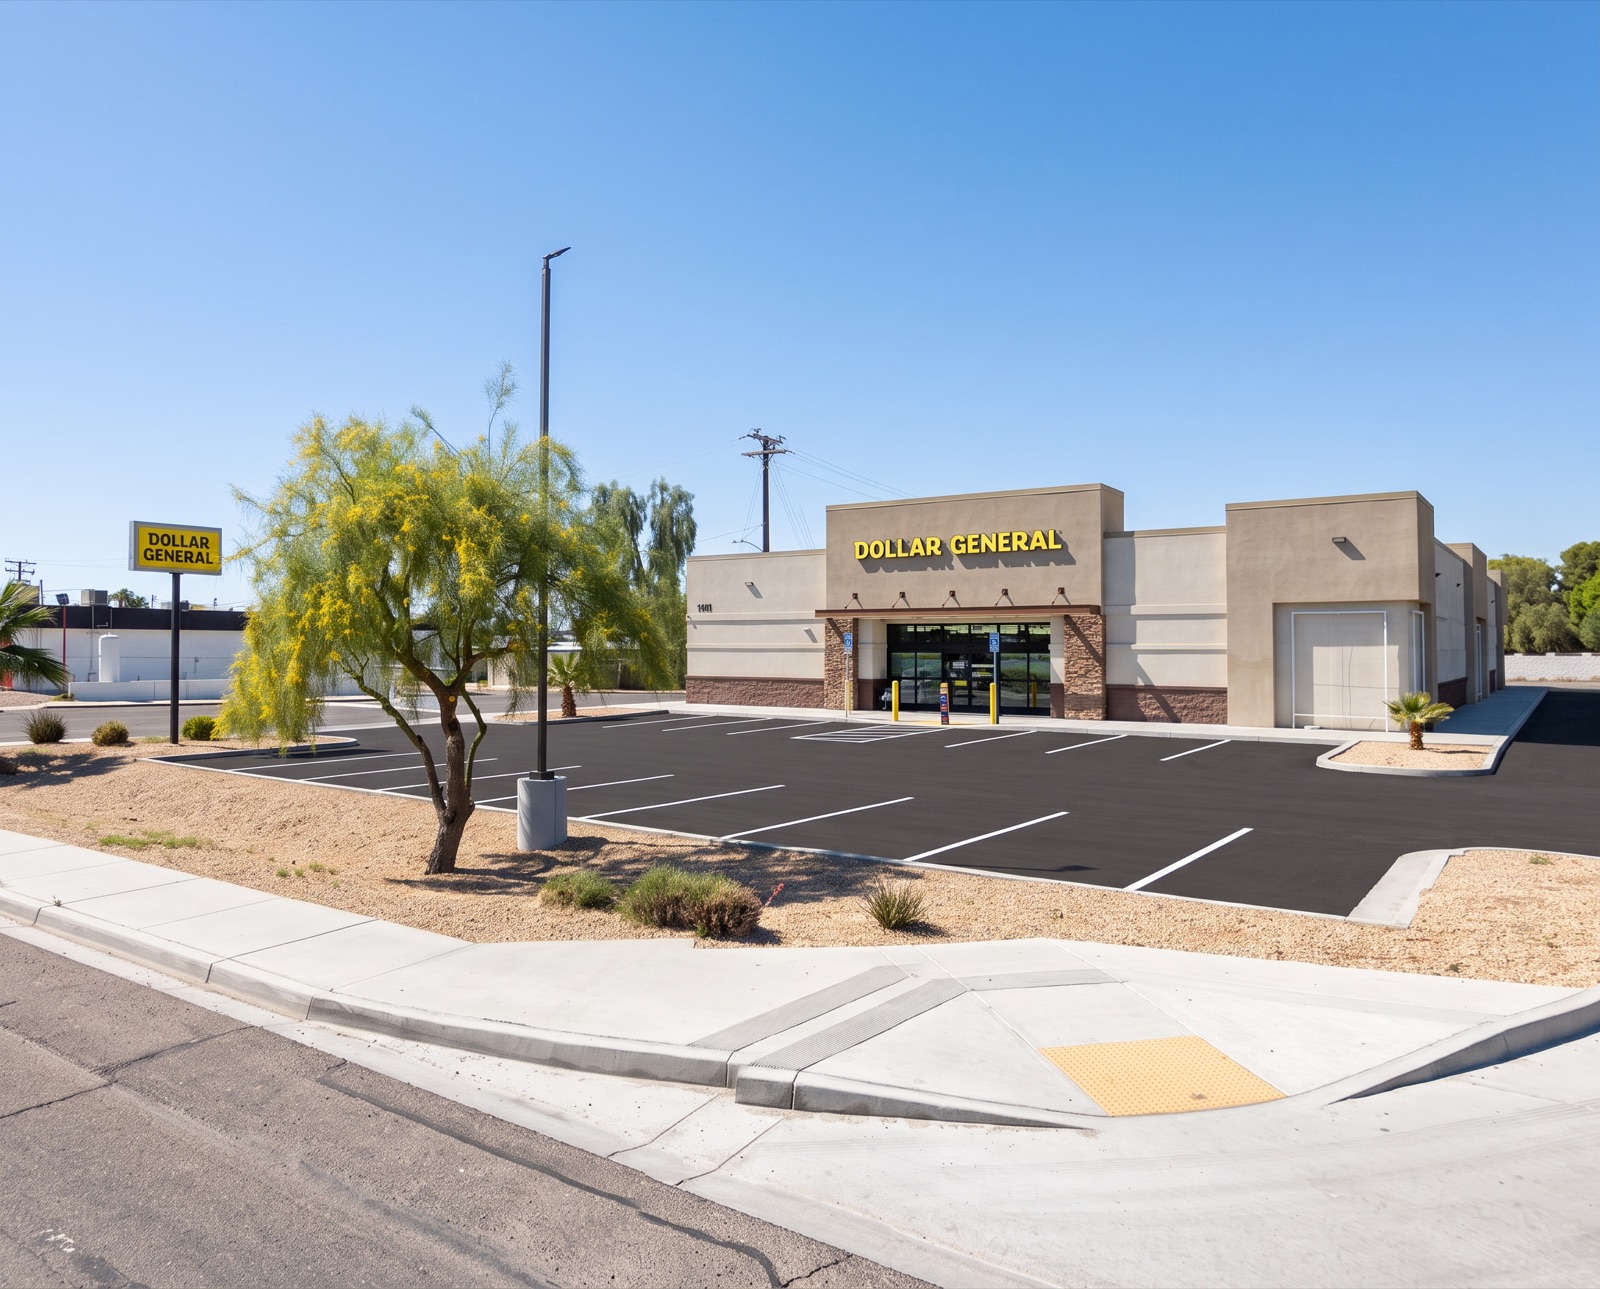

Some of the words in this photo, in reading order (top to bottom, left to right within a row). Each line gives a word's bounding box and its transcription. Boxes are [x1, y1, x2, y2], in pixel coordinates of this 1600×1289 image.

[148, 532, 210, 549] DOLLAR
[854, 537, 942, 560] DOLLAR
[950, 529, 1062, 555] GENERAL
[143, 547, 214, 565] GENERAL
